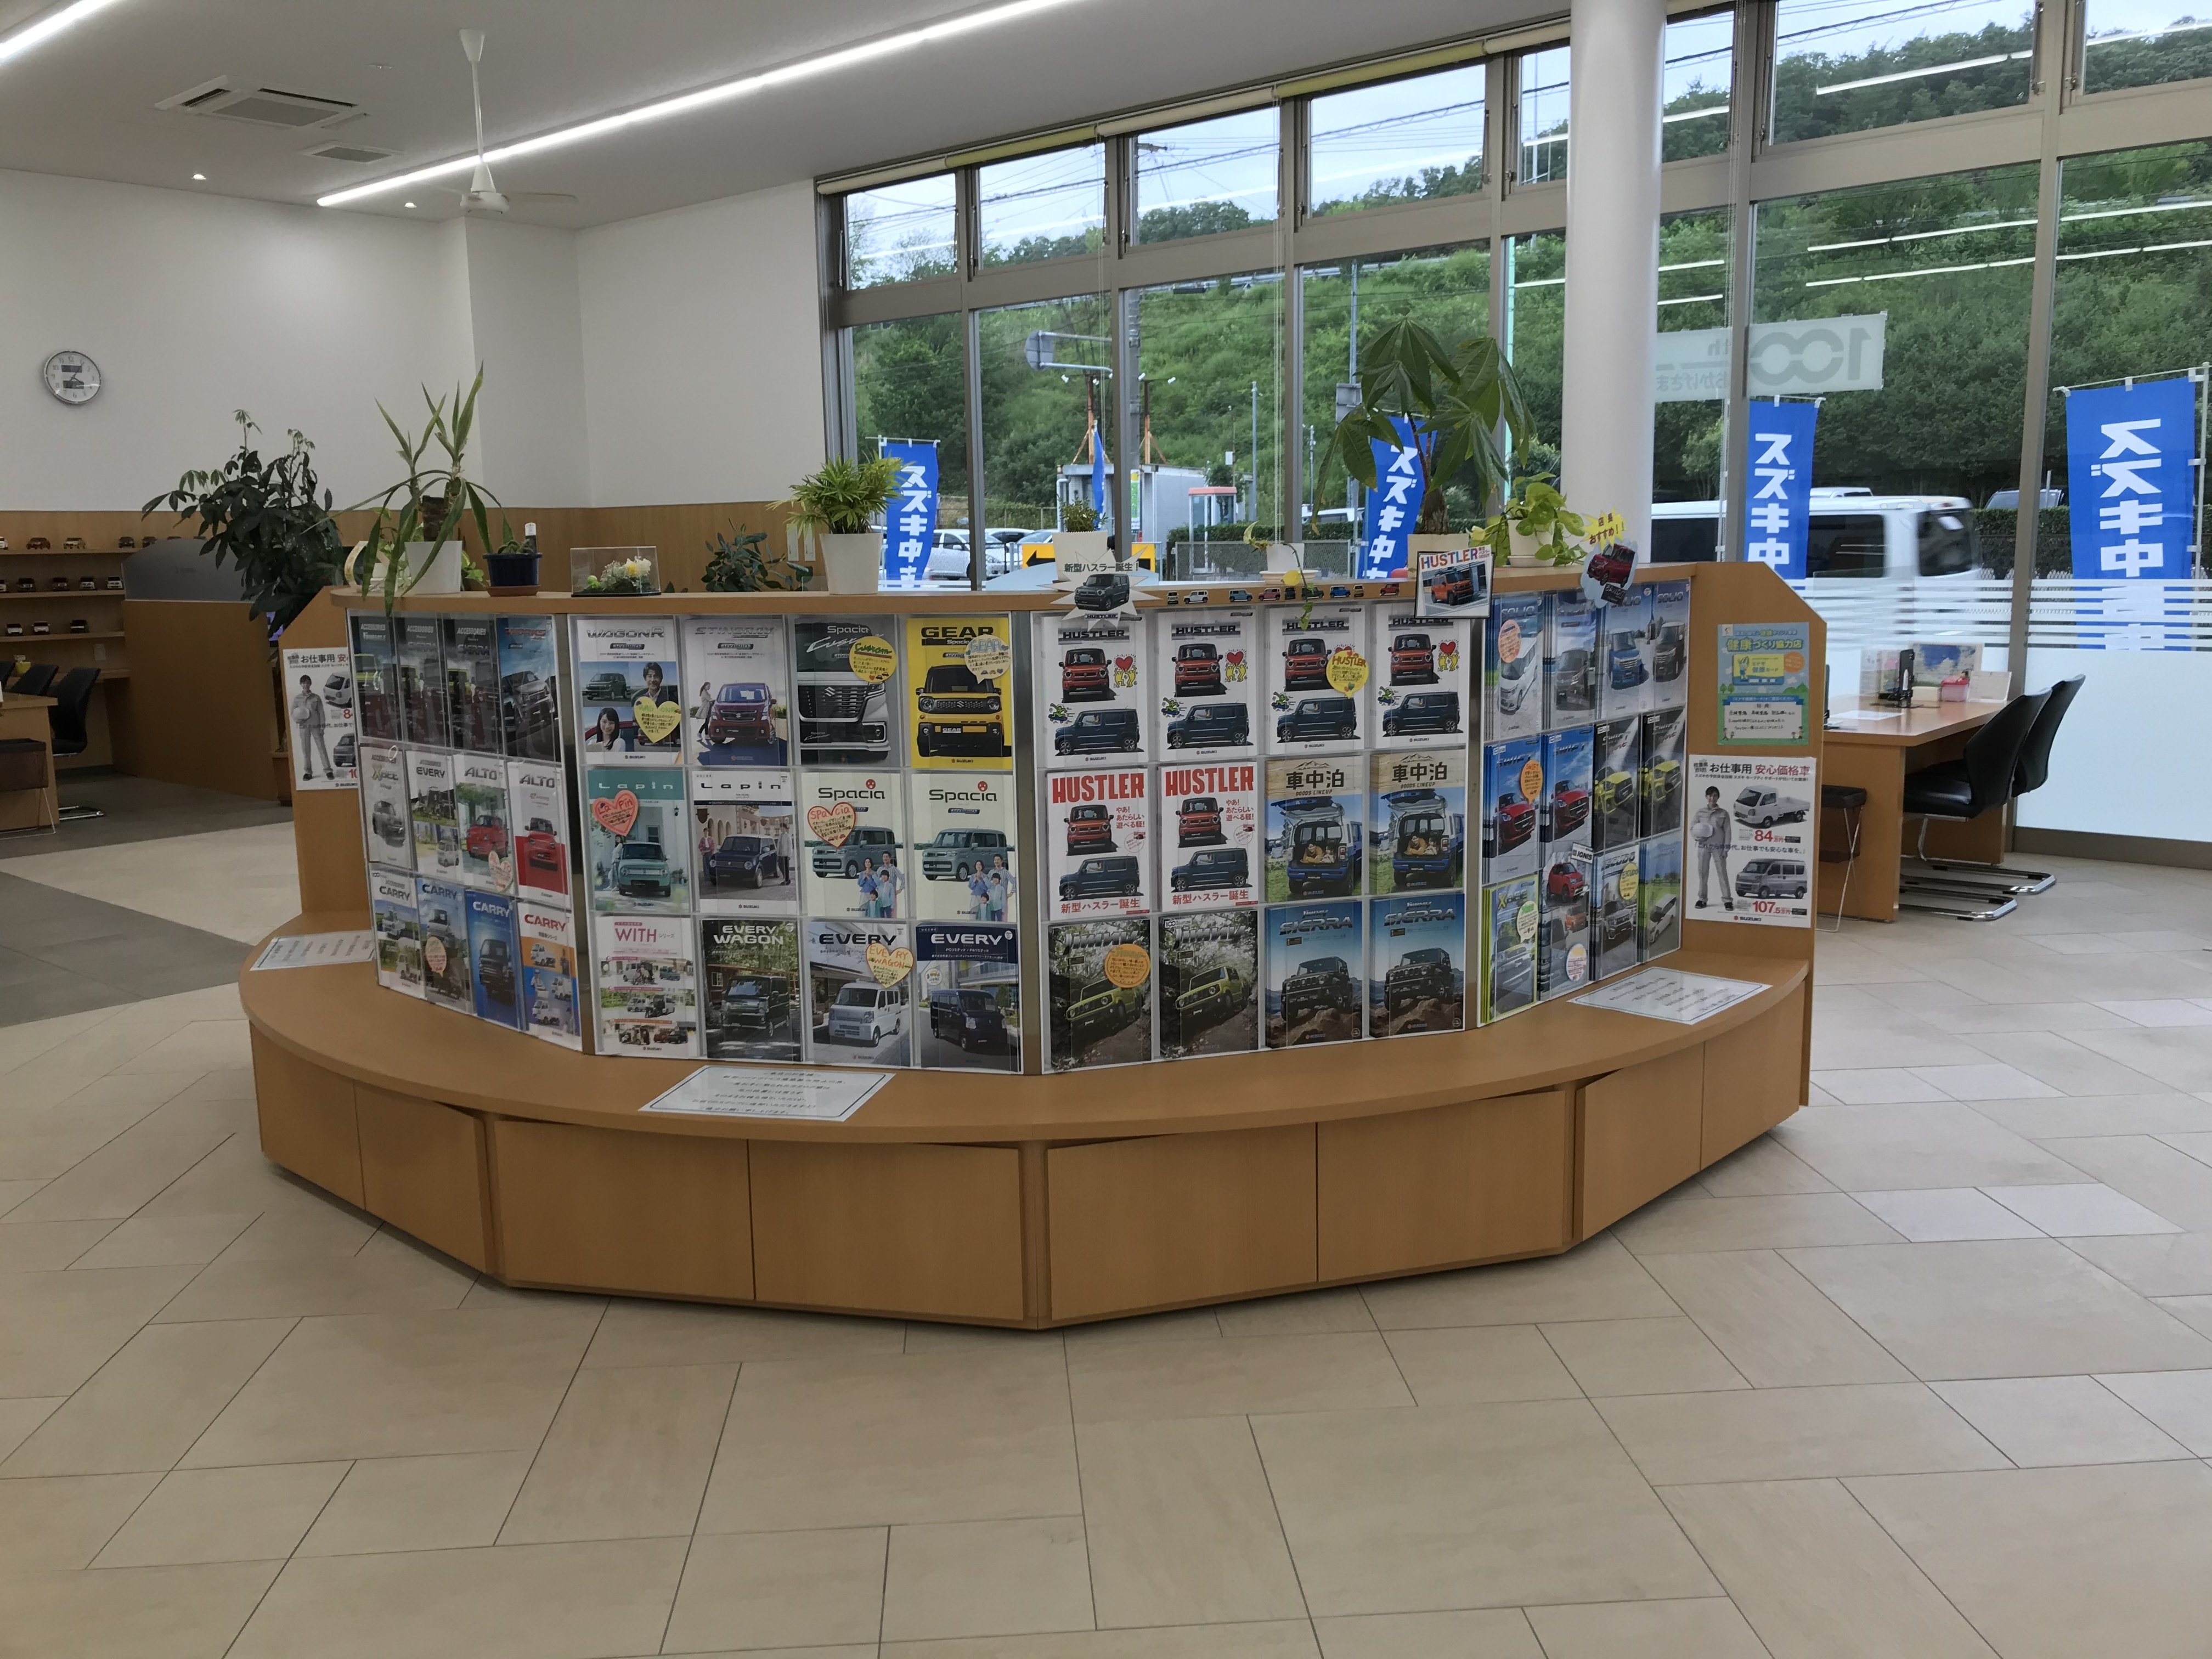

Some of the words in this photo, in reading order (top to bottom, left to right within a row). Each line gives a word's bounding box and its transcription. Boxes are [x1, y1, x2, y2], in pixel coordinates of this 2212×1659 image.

[1747, 433, 1795, 569] スズキ中
[1420, 548, 1479, 569] HUSTLER
[827, 625, 870, 635] Spacia
[921, 627, 994, 638] GEAR
[1063, 629, 1125, 639] HUSTLER
[1176, 625, 1237, 634] HUSTLER
[970, 638, 1002, 653] GEAR
[301, 654, 336, 664] お仕事用
[337, 653, 350, 663] 安
[1332, 656, 1367, 668] HUSTLER
[343, 709, 353, 719] 8
[416, 766, 445, 778] EVERY
[464, 767, 498, 780] ALTO
[1392, 761, 1448, 783] 車中泊
[1709, 763, 1753, 774] お仕事用
[1755, 764, 1810, 776] 安心価格車
[520, 775, 555, 788] ALTO
[1165, 766, 1254, 797] HUSTLER
[1286, 769, 1344, 790] 車中泊
[818, 787, 885, 801] Spacia
[1052, 772, 1144, 804] HUSTLER
[929, 789, 997, 803] Spacia
[1576, 851, 1593, 861] IGNIS
[379, 885, 410, 901] CARRY
[422, 884, 458, 900] CARRY
[1172, 890, 1249, 905] 新型ハスラー誕生
[472, 901, 510, 918] CARRY
[1060, 898, 1141, 914] 新型ハスラー誕生
[524, 913, 567, 932] CARRY
[1384, 909, 1457, 926] SIERRA
[721, 924, 777, 934] EVERY
[1279, 916, 1353, 935] SIERRA
[614, 928, 657, 943] WITH
[713, 934, 784, 945] WAGON
[819, 934, 897, 946] EVERY
[930, 933, 1003, 945] EVERY
[874, 958, 905, 969] WAGON
